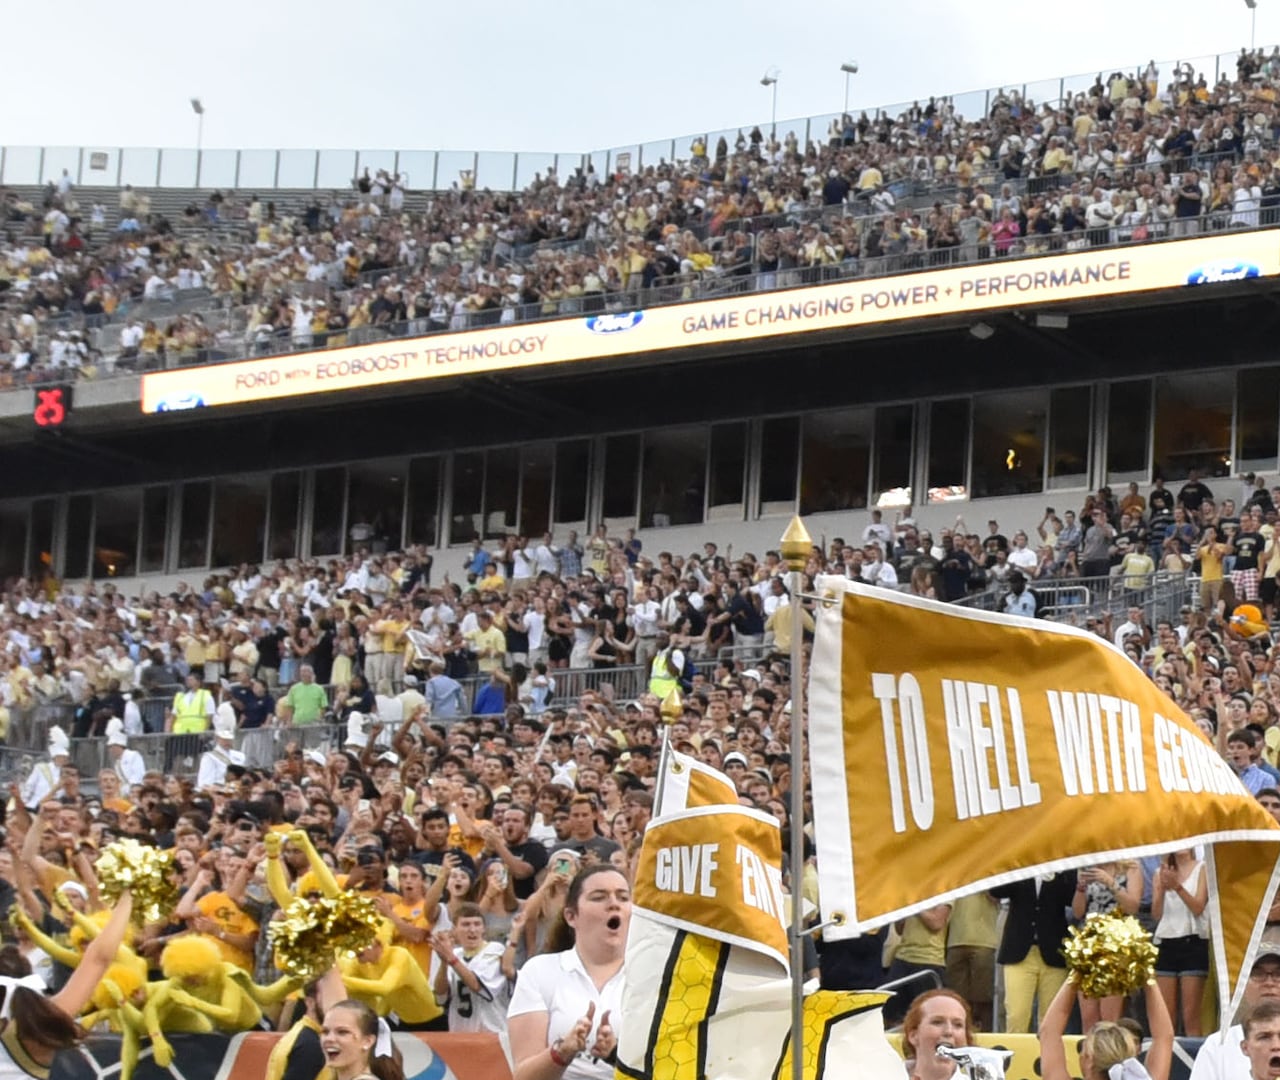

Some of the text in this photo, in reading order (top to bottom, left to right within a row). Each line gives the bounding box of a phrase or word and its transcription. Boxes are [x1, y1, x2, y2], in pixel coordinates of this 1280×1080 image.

[682, 311, 739, 334] GAME
[745, 296, 854, 326] CHANGING
[861, 285, 938, 311] POWER
[960, 261, 1131, 298] PERFORMANCE
[236, 370, 279, 389] FORD
[426, 336, 548, 364] TECHNOLOGY
[871, 672, 935, 833] TO
[941, 678, 1042, 820] HELL
[1046, 690, 1147, 796] WITH
[655, 843, 720, 898] GIVE
